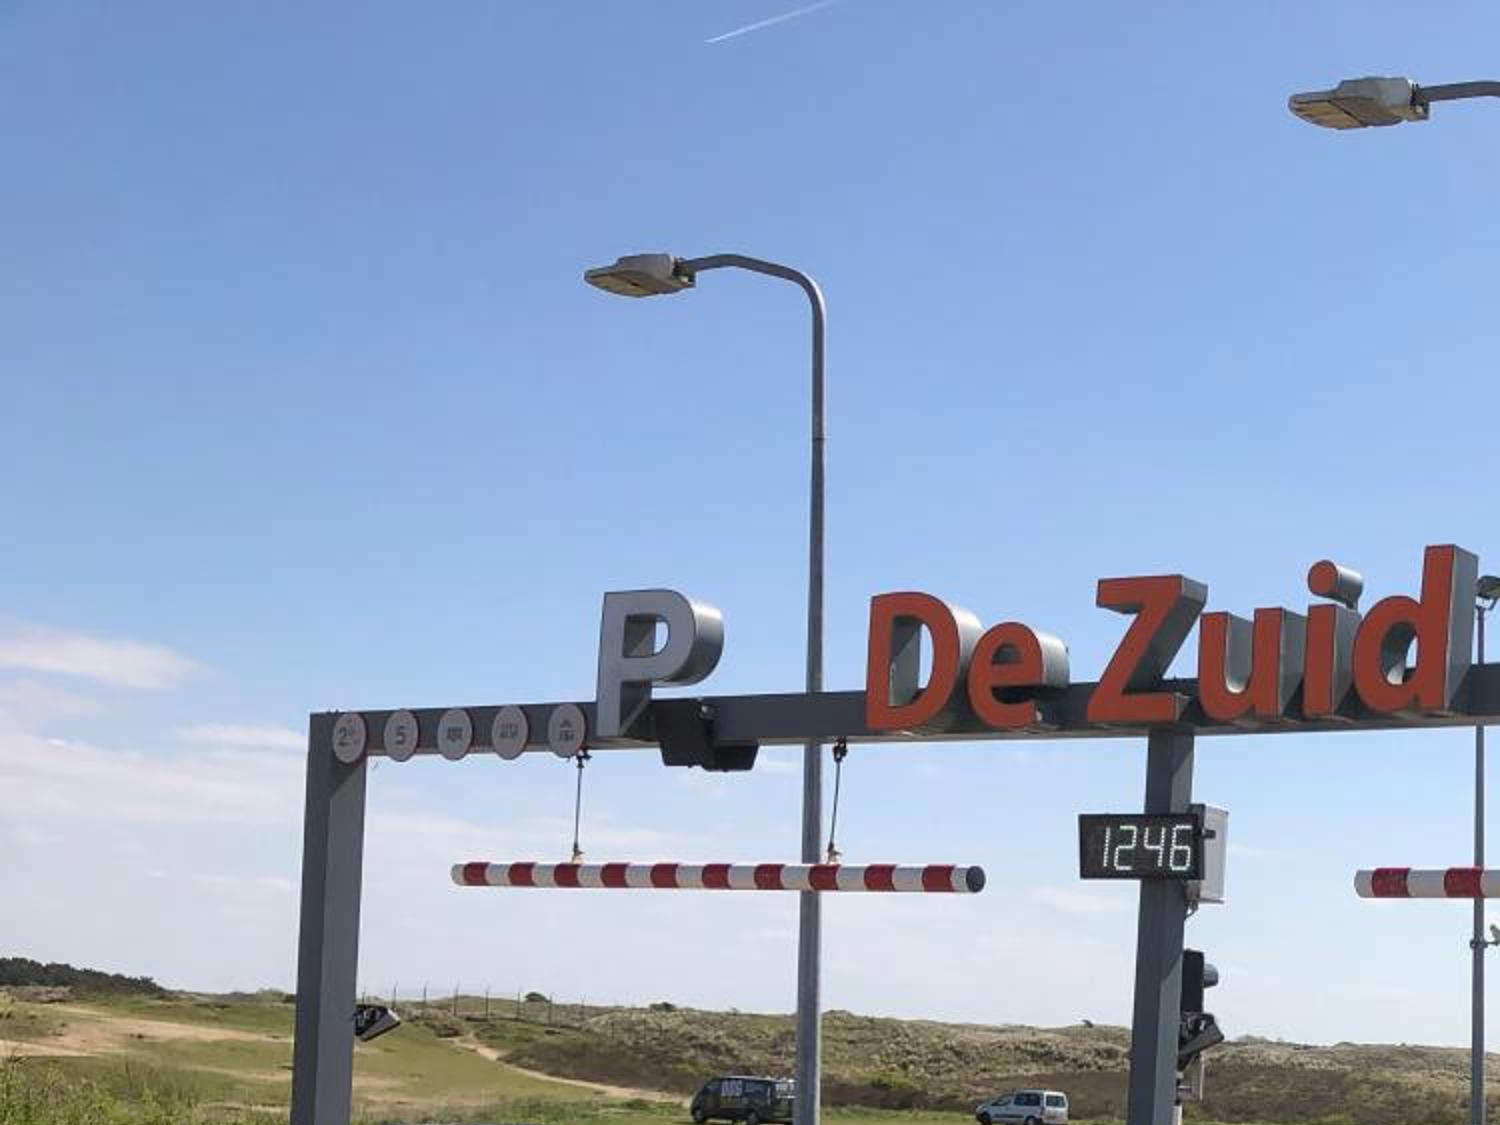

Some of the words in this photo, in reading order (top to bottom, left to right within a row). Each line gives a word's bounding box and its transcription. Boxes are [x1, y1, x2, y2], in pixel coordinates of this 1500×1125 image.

[597, 589, 706, 737] P
[866, 591, 1048, 731] De
[1088, 544, 1458, 723] Zuid
[394, 725, 407, 746] 5
[1103, 825, 1193, 871] 1246
